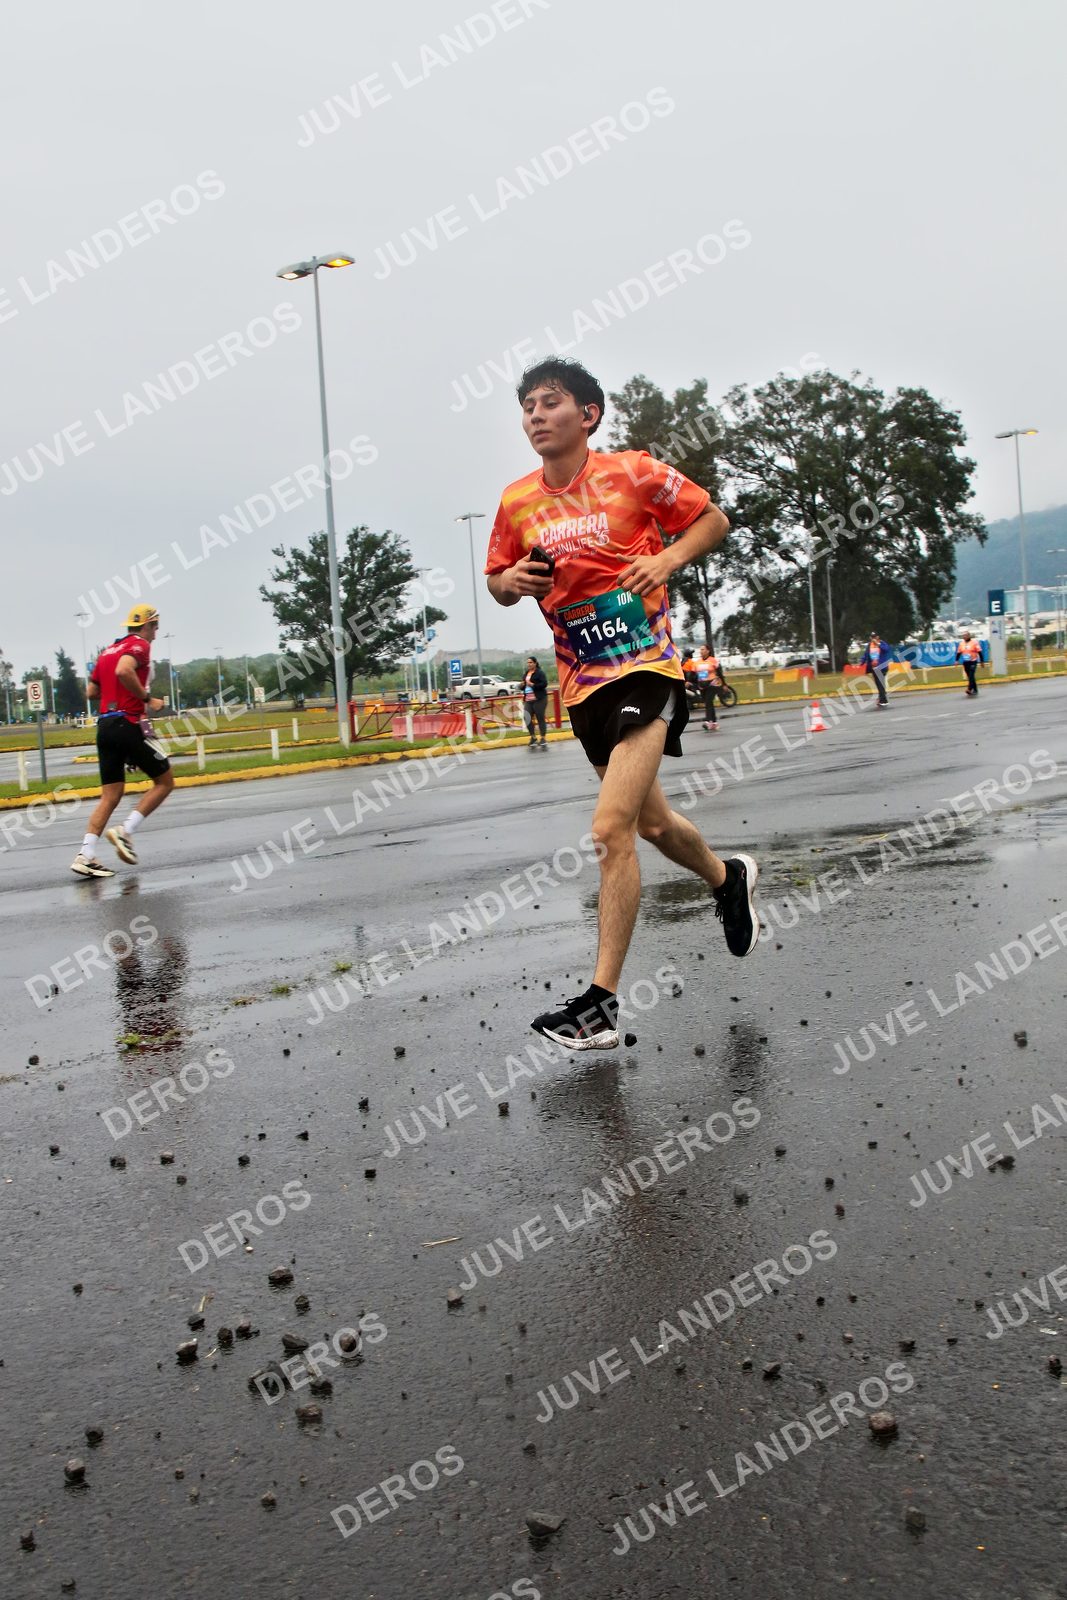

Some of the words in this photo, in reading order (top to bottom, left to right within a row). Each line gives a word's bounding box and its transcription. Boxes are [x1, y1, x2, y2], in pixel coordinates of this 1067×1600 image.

[540, 512, 608, 547] CARRERA
[546, 536, 594, 559] OMNILIFE
[616, 591, 633, 606] 10K
[991, 600, 1001, 612] E
[563, 603, 596, 620] CARRERA
[566, 616, 590, 627] OMNILIFE
[580, 617, 628, 644] 1164
